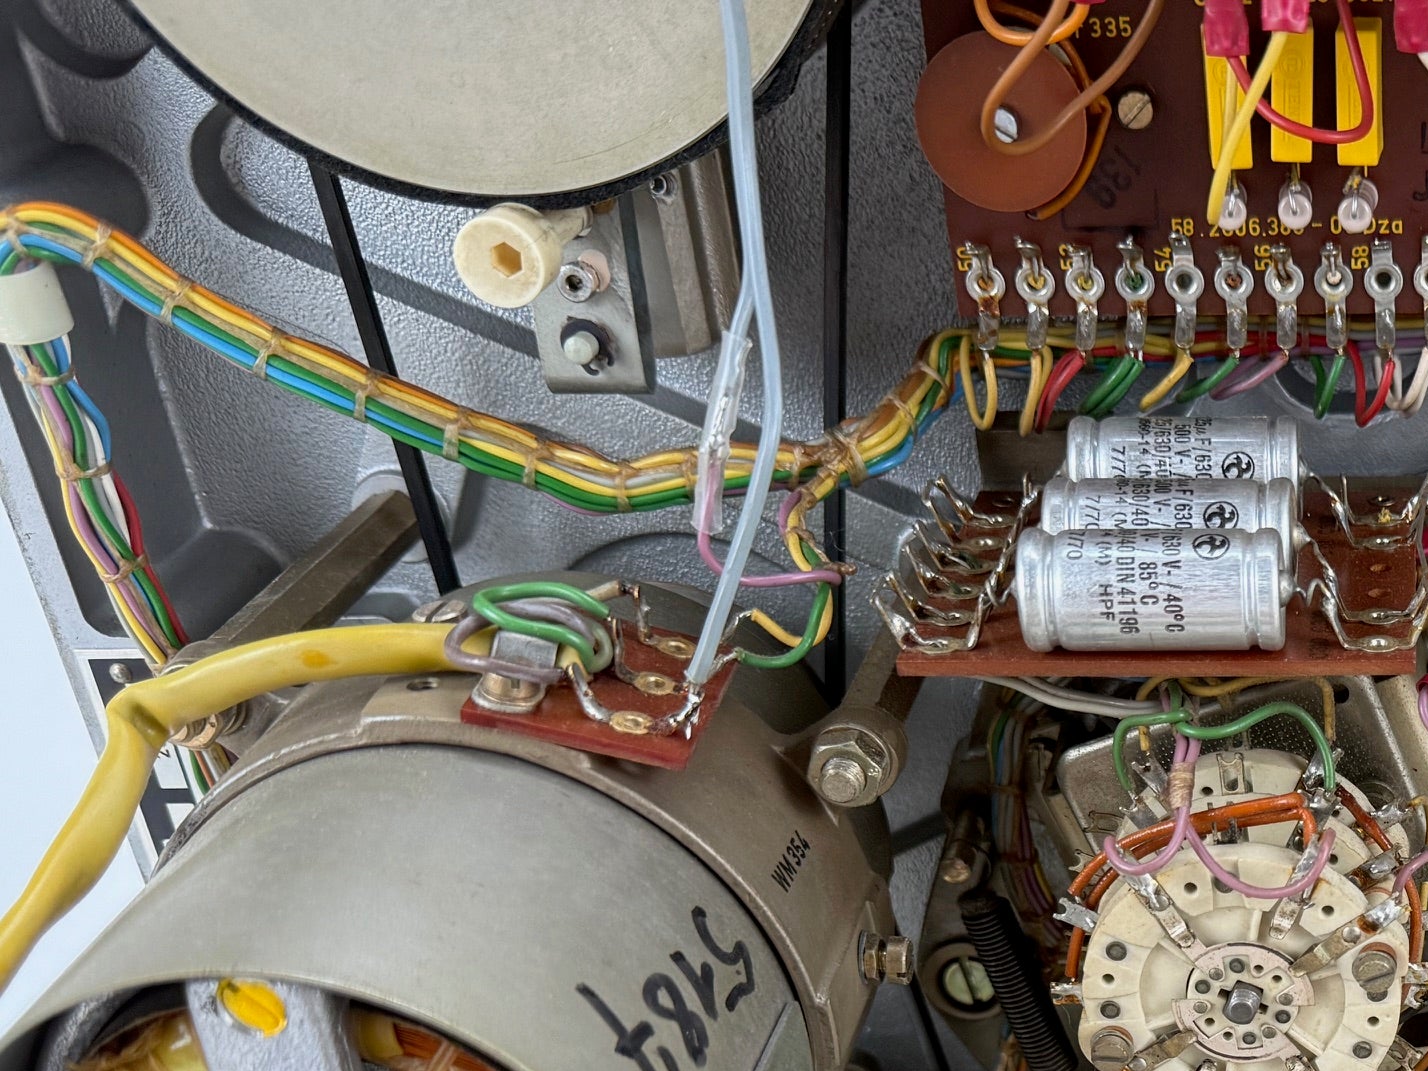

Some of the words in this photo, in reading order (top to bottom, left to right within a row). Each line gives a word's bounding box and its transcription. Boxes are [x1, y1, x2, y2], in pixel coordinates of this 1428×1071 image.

[1088, 15, 1132, 38] 335
[1154, 246, 1172, 272] 54
[1254, 244, 1273, 271] 56
[1351, 244, 1369, 270] 58
[1115, 556, 1137, 584] DIN
[1100, 583, 1116, 622] HPF
[1116, 586, 1141, 635] 41196
